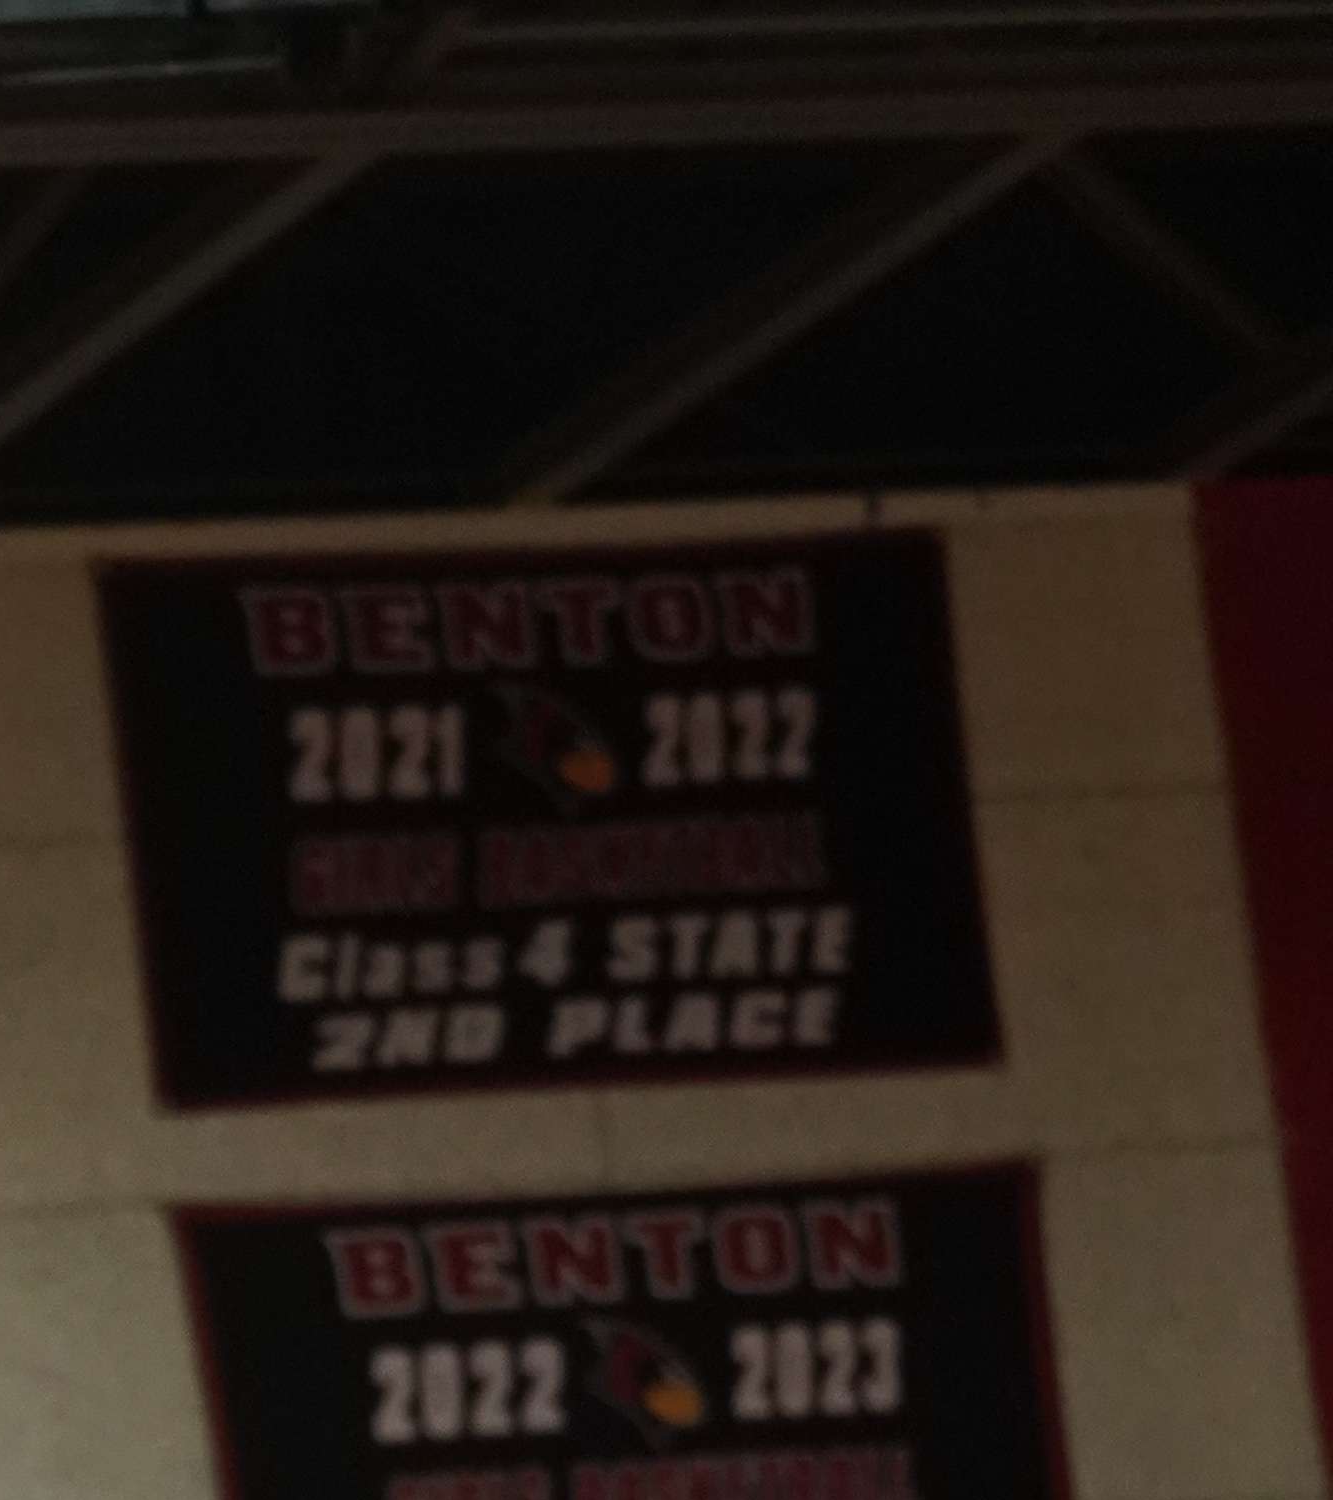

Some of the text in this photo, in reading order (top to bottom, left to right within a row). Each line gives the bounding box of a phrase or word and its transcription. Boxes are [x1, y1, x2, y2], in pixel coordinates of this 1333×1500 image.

[239, 566, 819, 677] BENTON
[286, 683, 820, 804] 2021 2022
[276, 903, 857, 1003] Class 4 STATE
[309, 985, 846, 1072] 2ND PLACE
[324, 1198, 906, 1321] BENTON
[368, 1315, 904, 1445] 2022 2023
